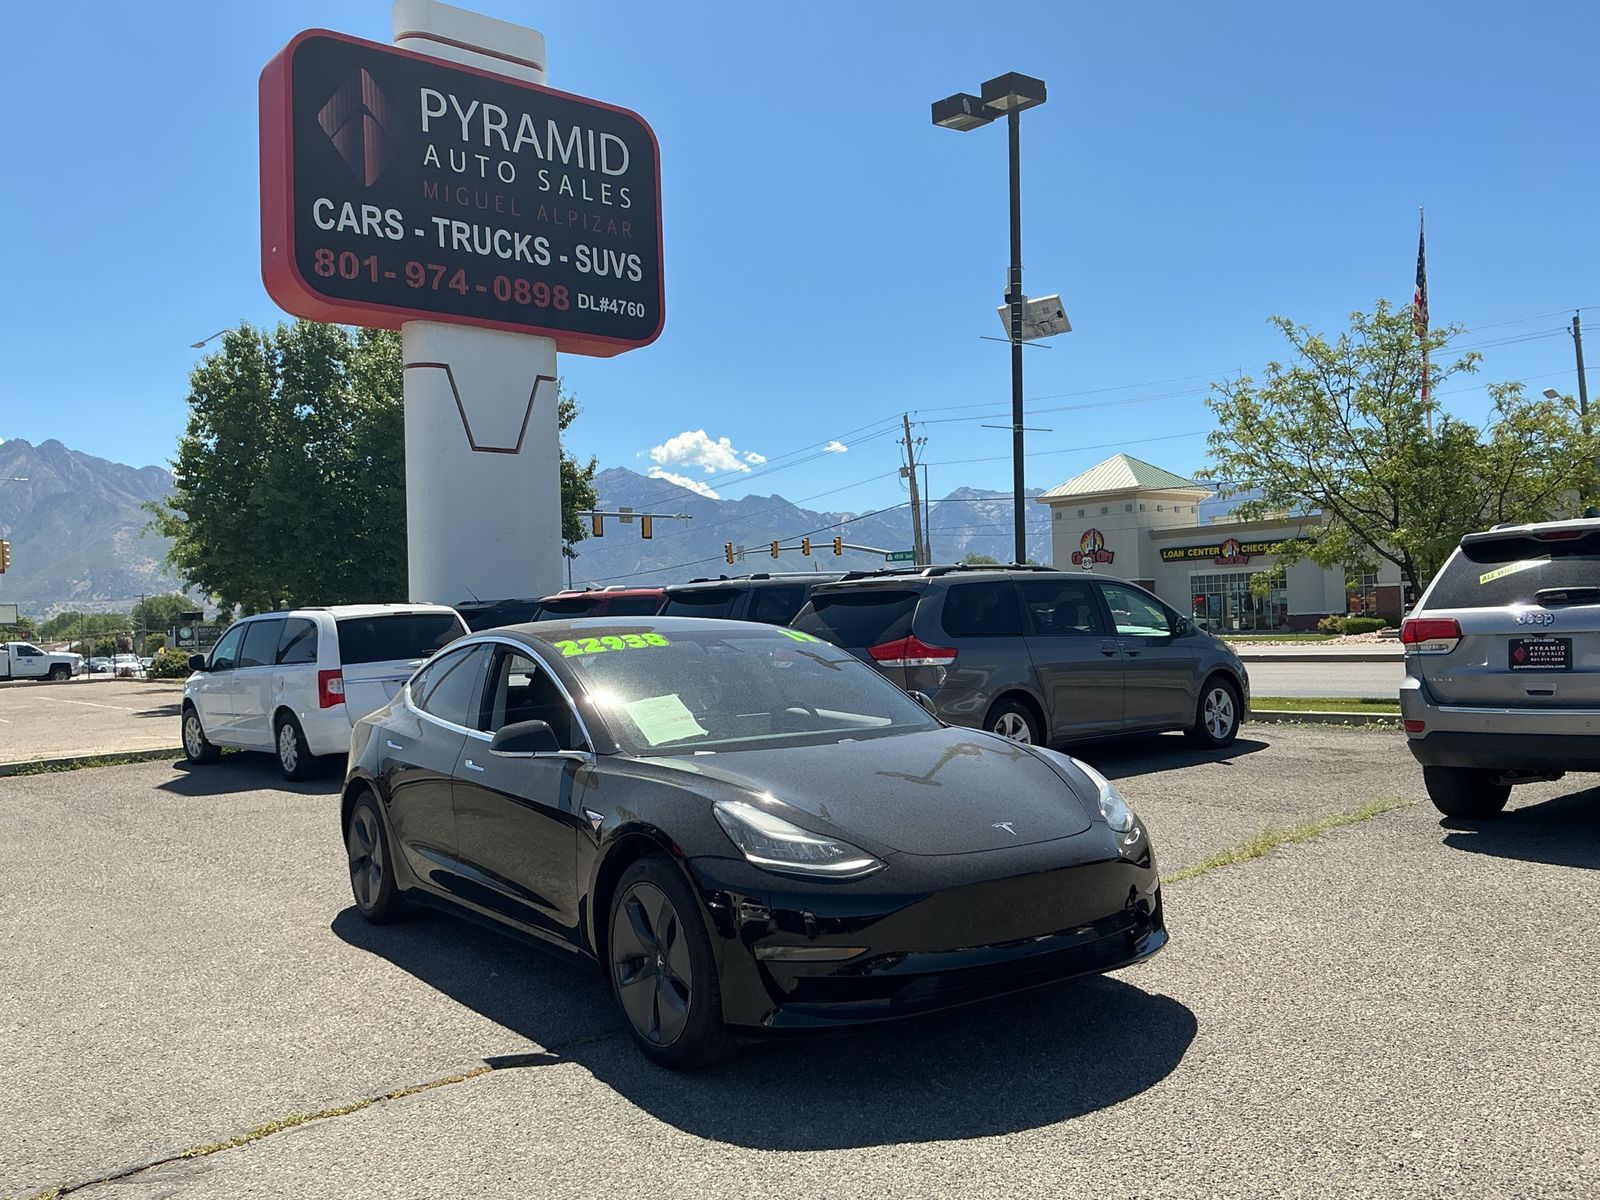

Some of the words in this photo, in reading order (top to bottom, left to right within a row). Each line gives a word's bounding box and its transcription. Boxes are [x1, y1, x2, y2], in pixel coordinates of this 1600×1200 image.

[420, 87, 630, 177] PYRAMID
[424, 144, 517, 184] AUTO
[538, 169, 633, 209] SALES
[424, 180, 521, 217] MIGUEL
[537, 204, 633, 239] ALPIZAR
[313, 197, 404, 241] CARS
[431, 217, 551, 266] TRUCKS
[575, 244, 643, 282] SUVS
[577, 293, 646, 318] DL#4760
[1096, 549, 1115, 564] City
[1163, 549, 1185, 559] LOAN
[1188, 546, 1220, 557] CENTER
[1241, 542, 1269, 553] CHECK
[1482, 573, 1496, 582] ALL
[1515, 611, 1555, 626] Jeep
[554, 632, 670, 657] 22938
